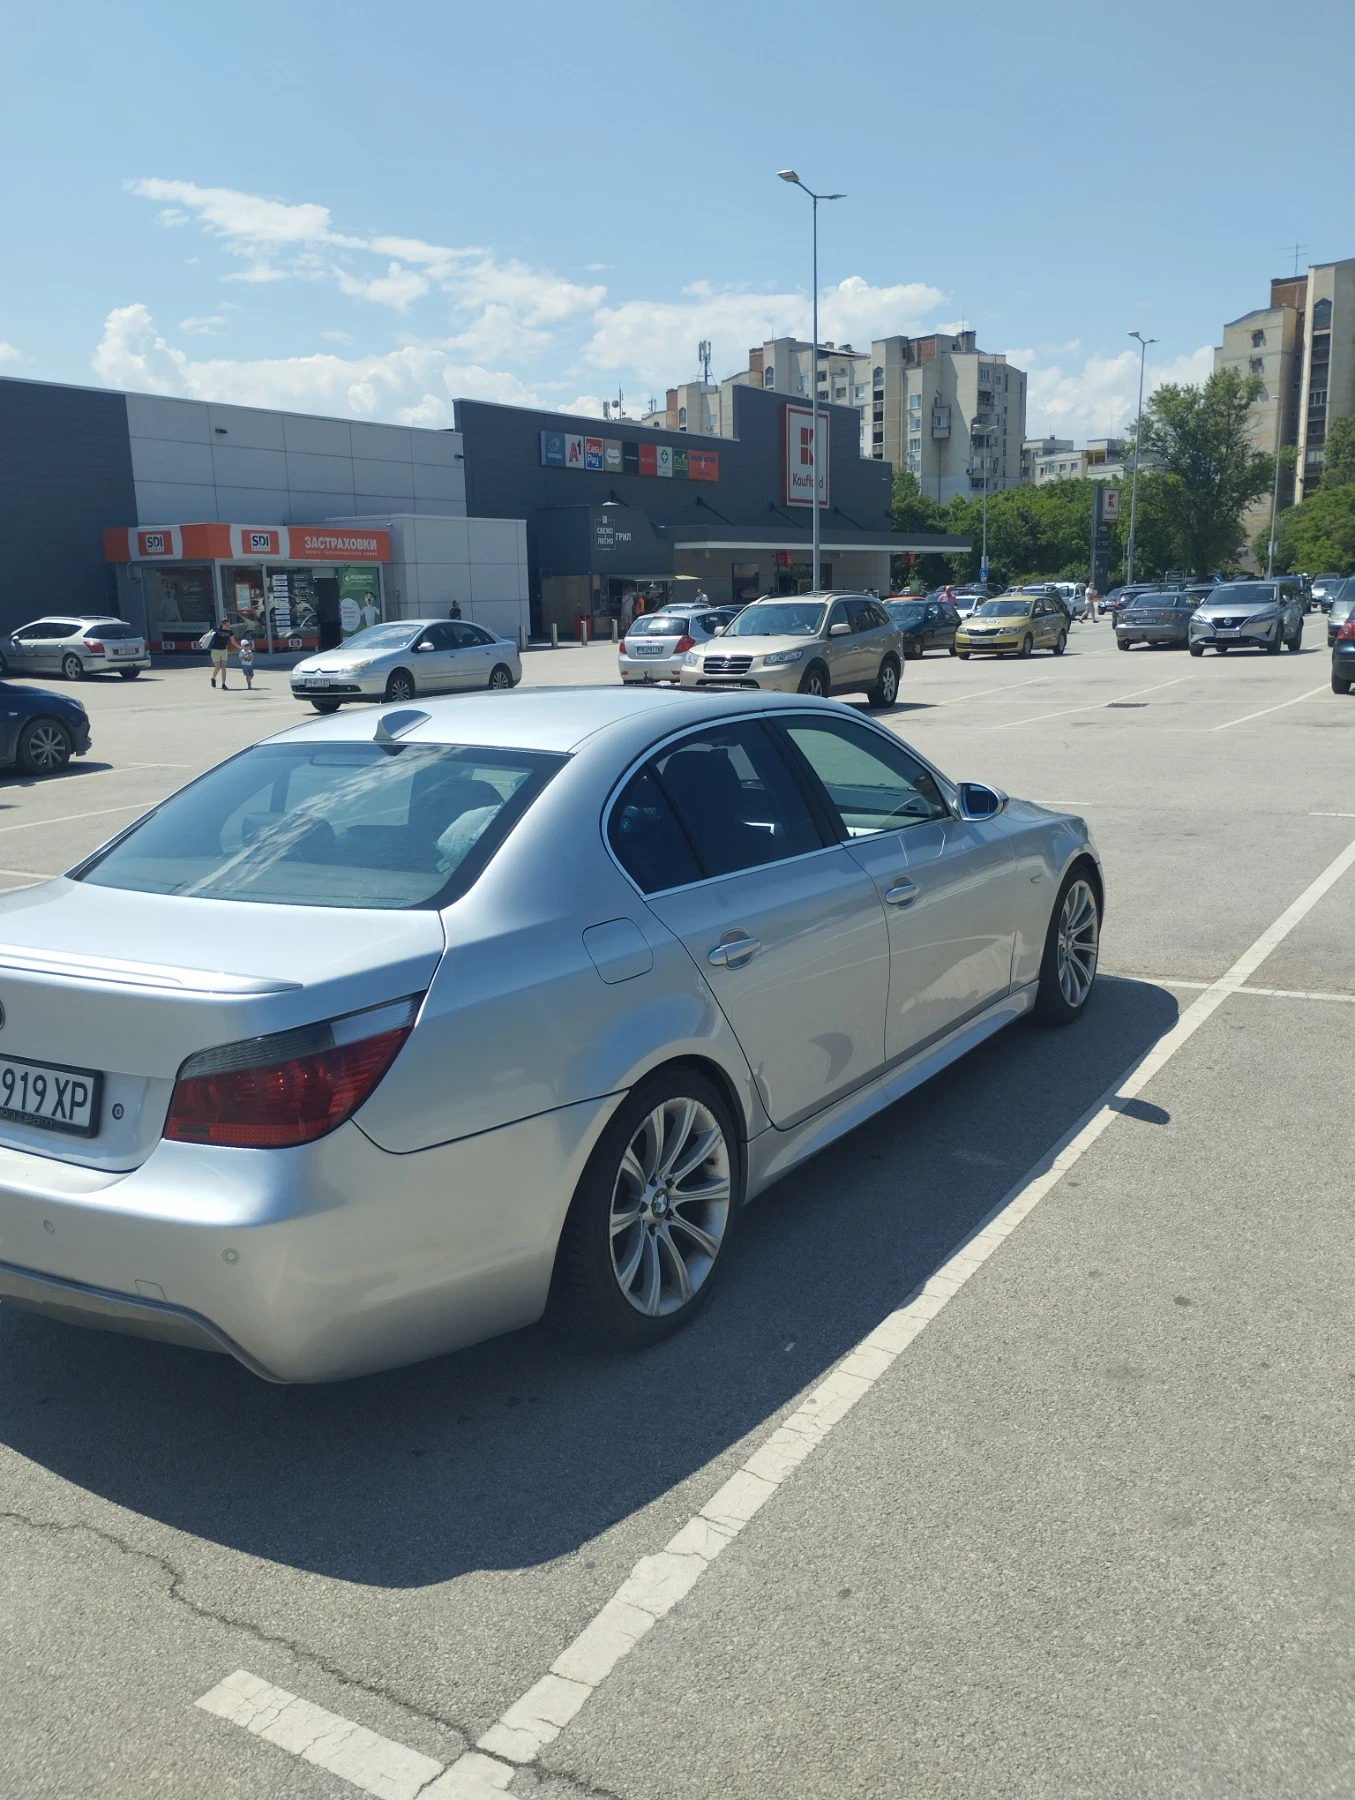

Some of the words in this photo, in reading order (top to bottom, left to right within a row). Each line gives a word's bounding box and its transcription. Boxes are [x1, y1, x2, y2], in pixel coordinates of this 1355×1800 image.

[568, 440, 581, 463] A1
[587, 443, 602, 456] Easy
[587, 454, 599, 467] Pay
[792, 472, 824, 489] Kaufld
[596, 527, 614, 535] СВЕЖО
[615, 532, 632, 542] ГРИЛ
[147, 536, 163, 548] SDI
[251, 535, 269, 547] SDI
[304, 536, 378, 551] ЗАСТРАХОВКИ
[597, 537, 614, 545] ЛЕСНО
